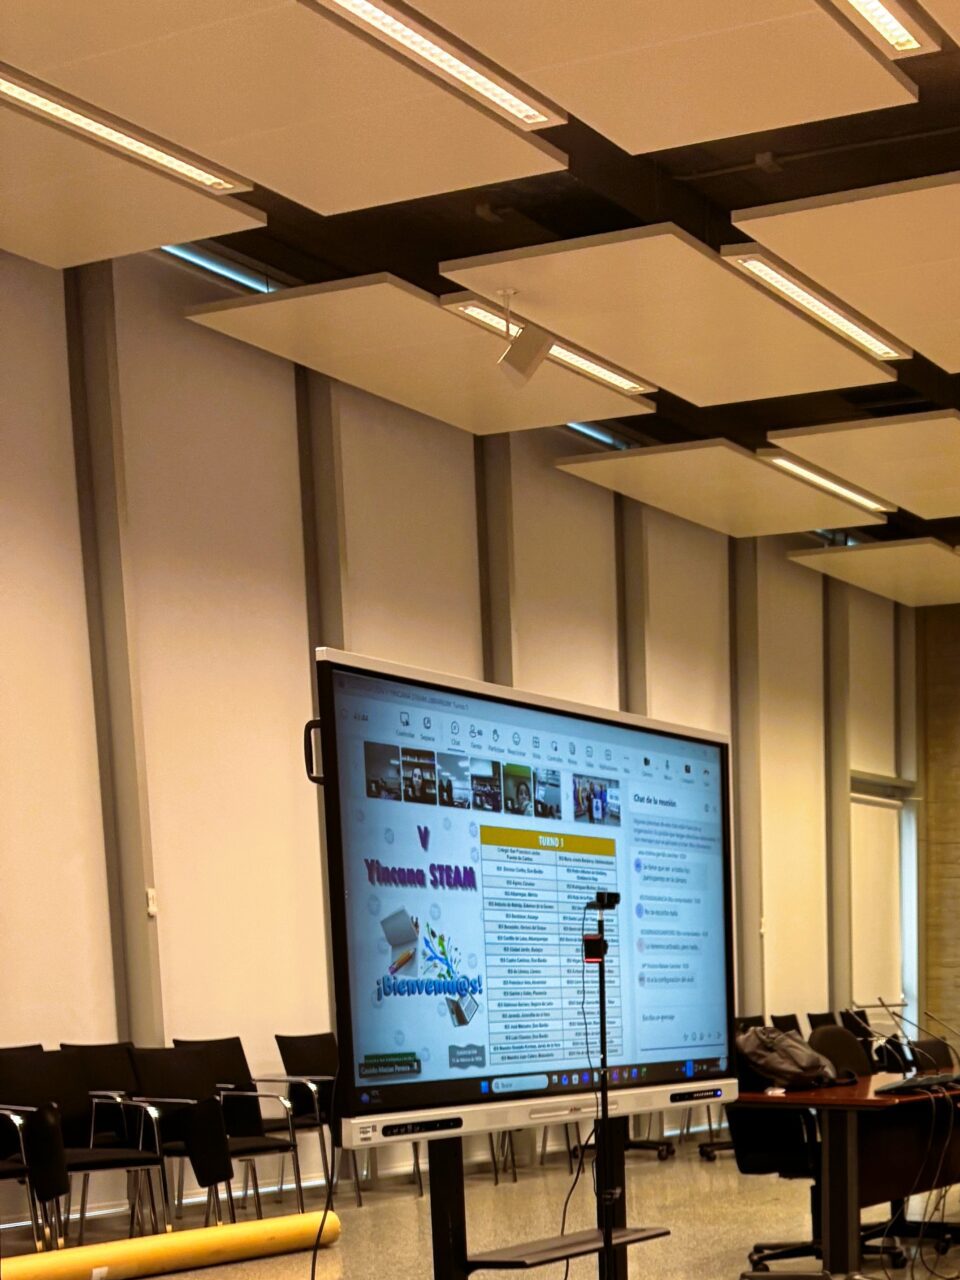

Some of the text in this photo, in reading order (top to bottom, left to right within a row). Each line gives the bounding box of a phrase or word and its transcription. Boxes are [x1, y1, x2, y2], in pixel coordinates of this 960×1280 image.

[417, 825, 430, 851] V
[364, 858, 477, 891] Yincana STEAM
